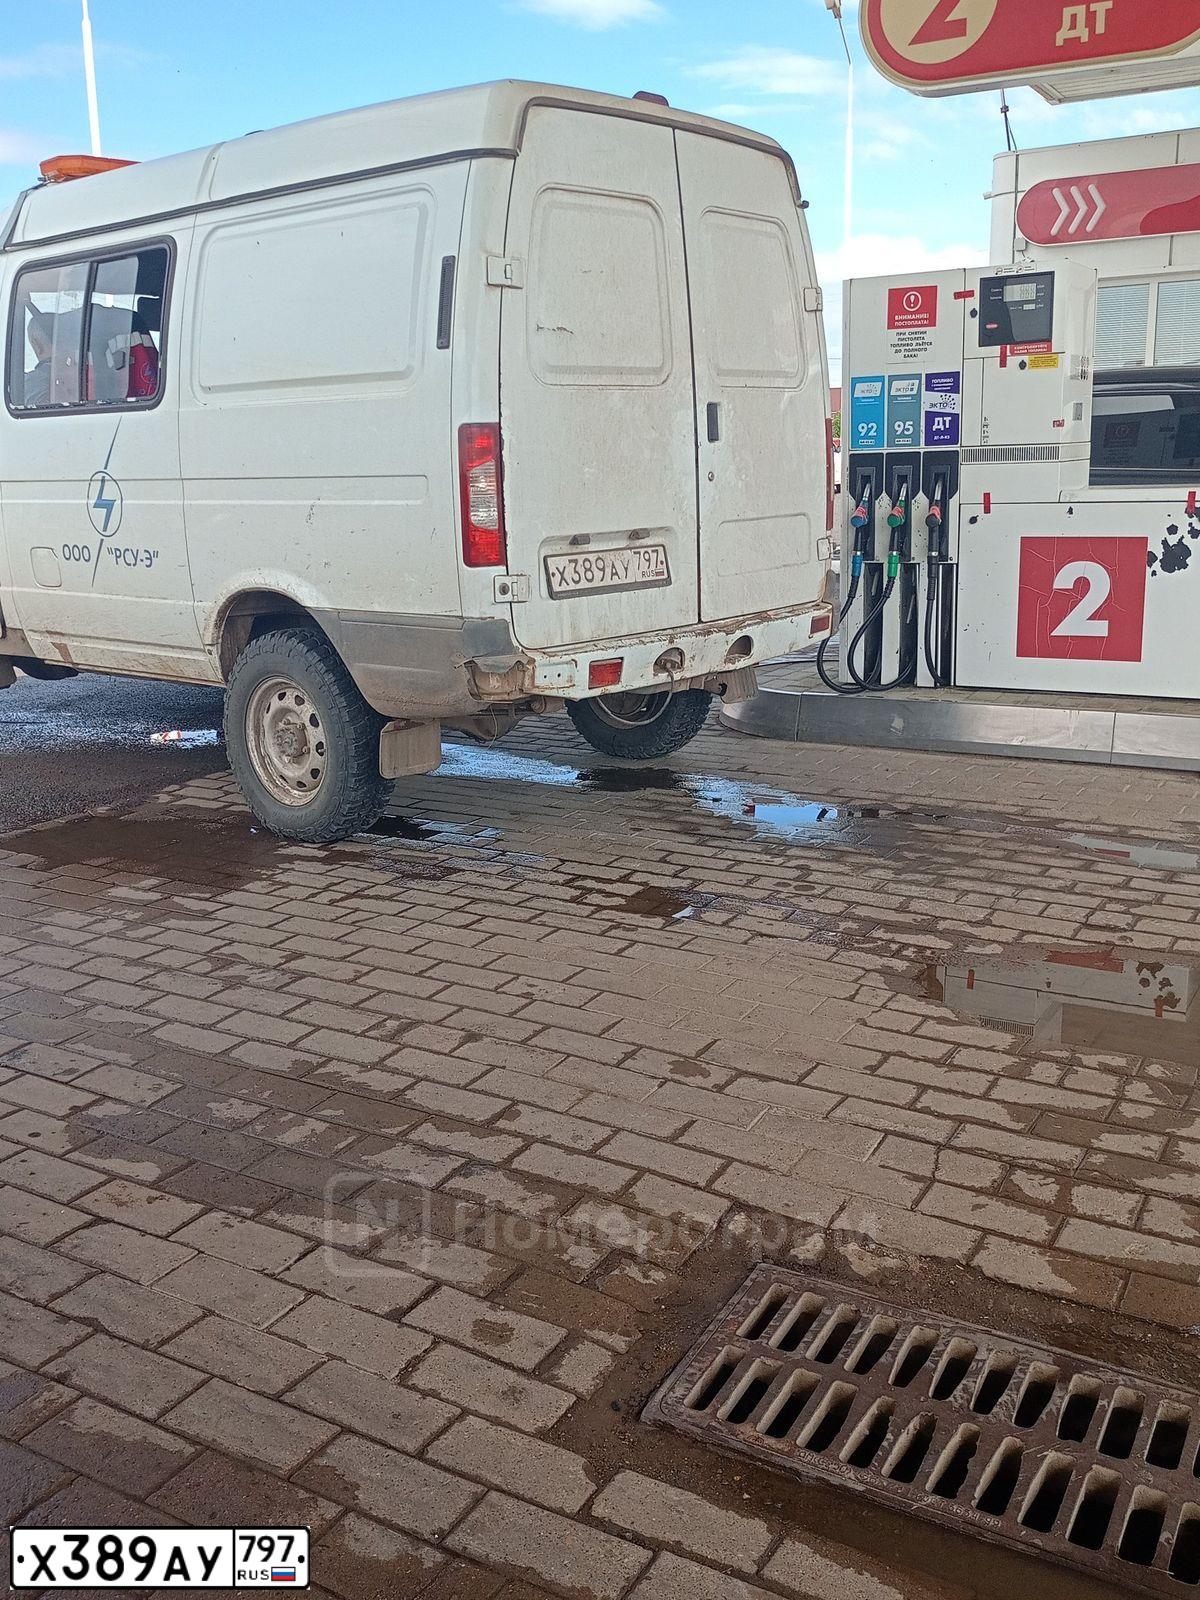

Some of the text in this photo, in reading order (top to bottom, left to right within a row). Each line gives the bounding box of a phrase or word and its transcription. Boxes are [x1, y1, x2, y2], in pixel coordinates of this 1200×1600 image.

[1055, 1, 1113, 46] ДТ
[928, 402, 949, 410] ЭКТО
[857, 422, 878, 437] 92
[894, 420, 915, 436] 95
[932, 416, 953, 432] ДТ
[62, 543, 160, 569] ООО "РСУ-Э"
[555, 548, 660, 587] Х389АУ 797
[641, 569, 656, 579] RUS
[1050, 560, 1111, 637] 2
